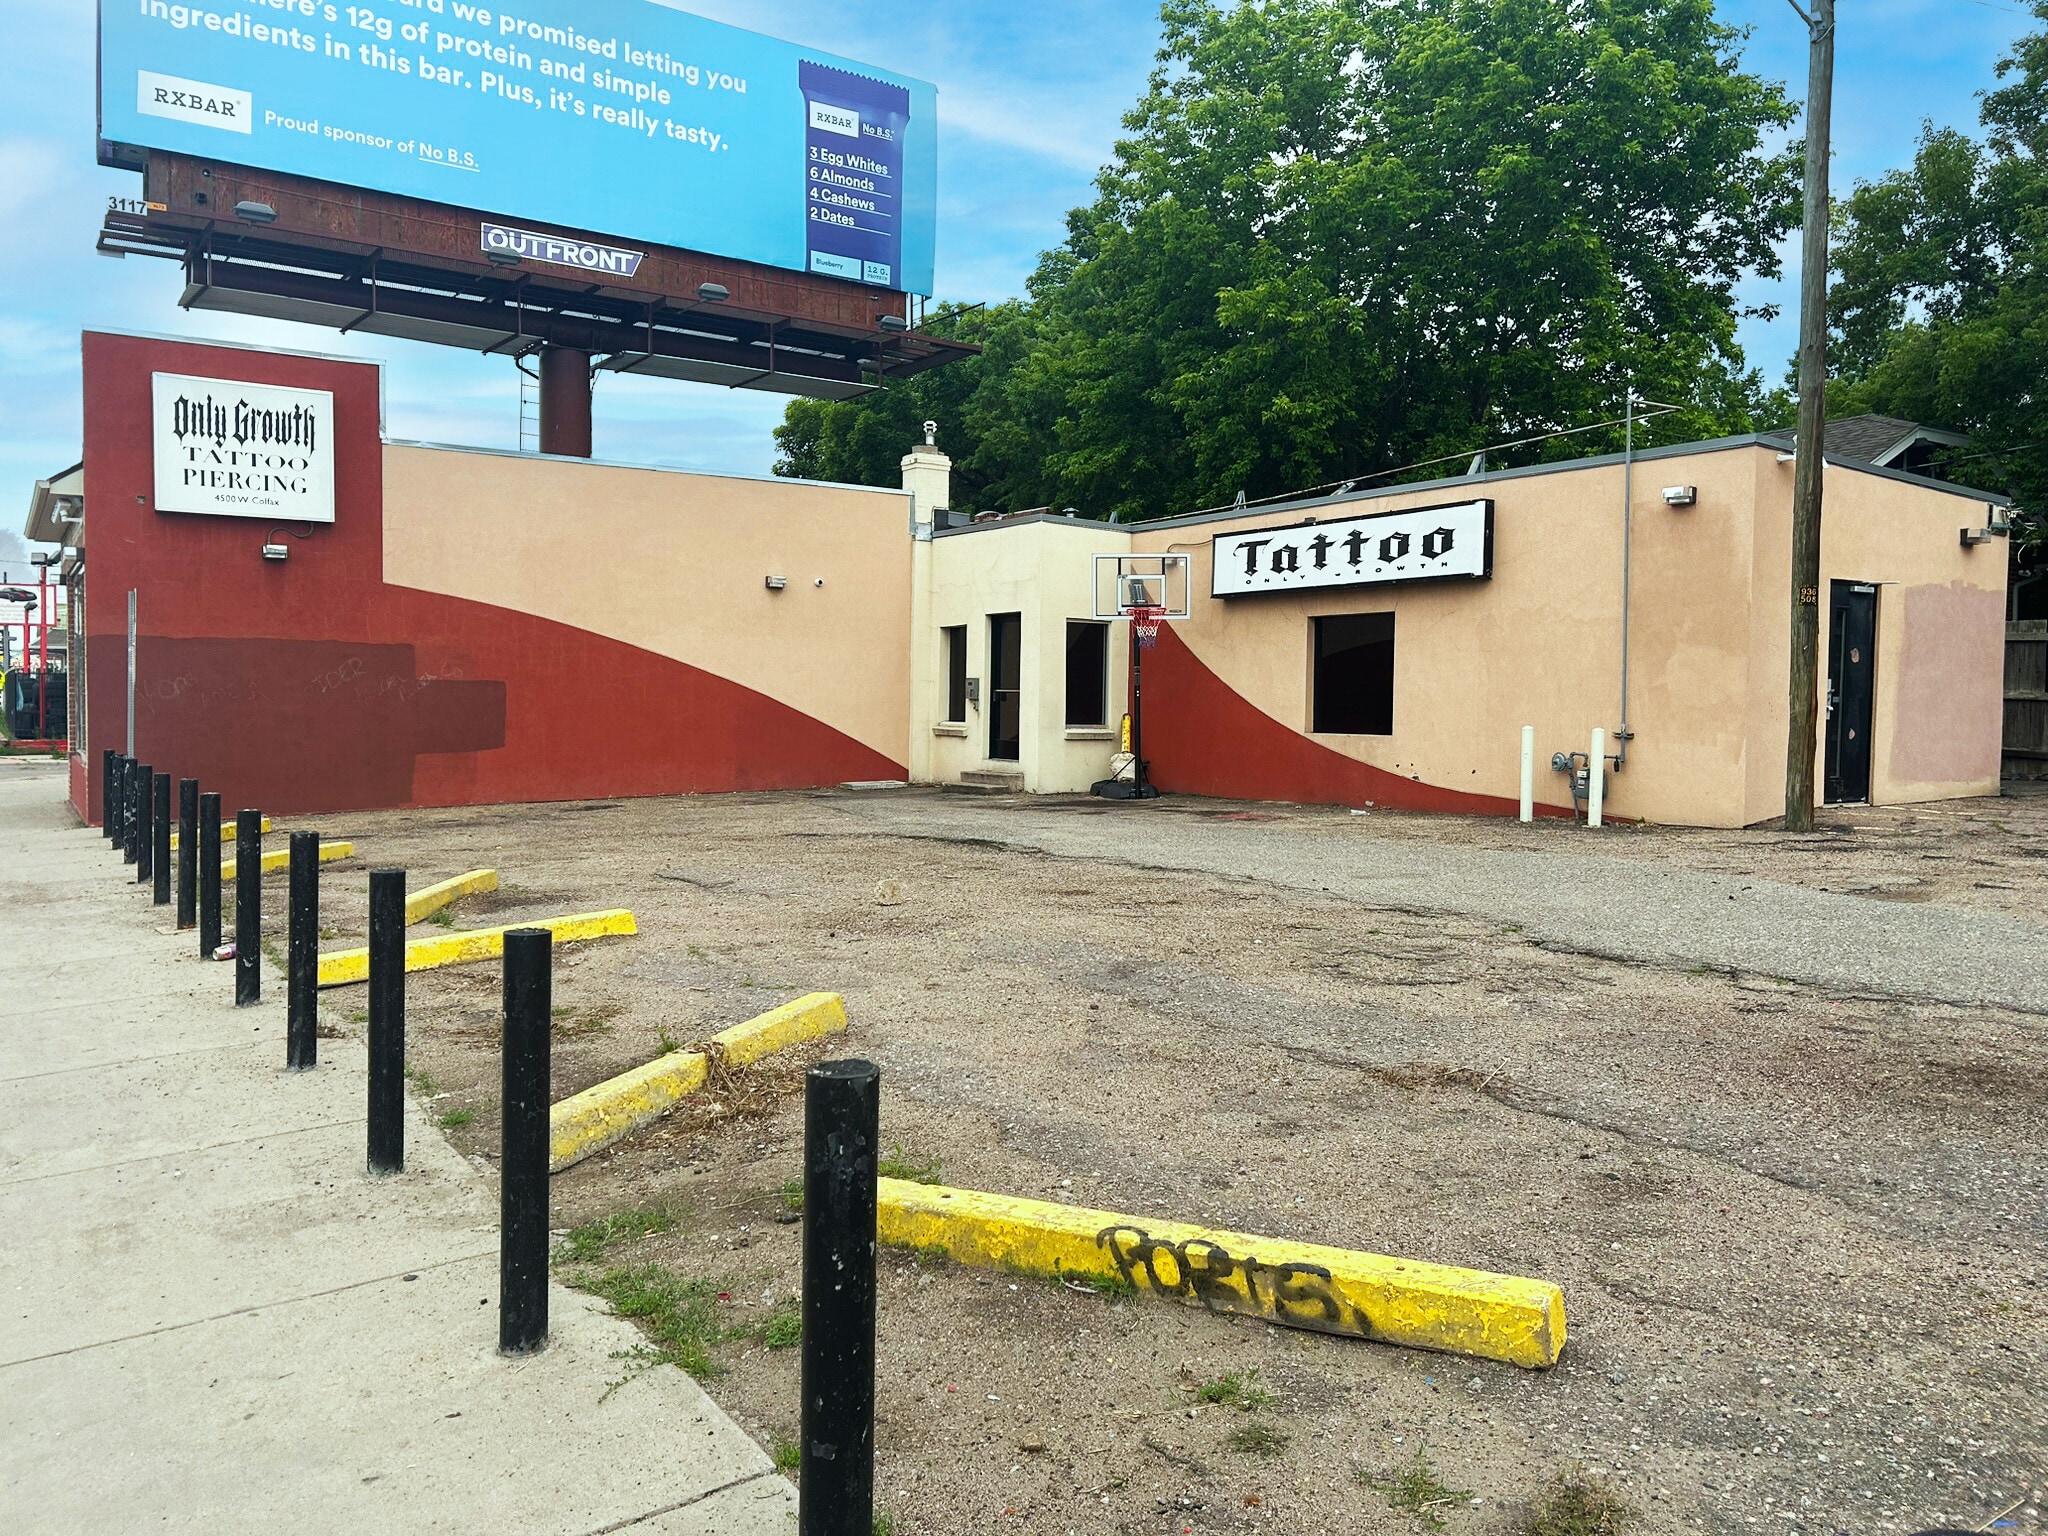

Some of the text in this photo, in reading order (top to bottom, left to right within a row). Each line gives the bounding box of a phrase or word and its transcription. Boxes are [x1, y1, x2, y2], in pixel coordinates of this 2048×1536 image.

[345, 6, 393, 41] 12g
[400, 21, 430, 44] of
[436, 31, 532, 70] protein
[539, 62, 585, 84] and
[592, 68, 671, 105] simple
[451, 2, 492, 26] we
[500, 14, 617, 60] promised
[624, 41, 700, 86] letting
[705, 69, 747, 94] you
[154, 87, 236, 118] RXBAR
[324, 32, 350, 60] in
[358, 43, 411, 74] this
[419, 55, 472, 89] bar.
[481, 70, 543, 110] Plus,
[550, 87, 586, 116] it's
[592, 103, 660, 137] really
[664, 118, 729, 152] tasty.
[816, 111, 852, 129] RXBAR
[862, 122, 875, 135] No
[264, 109, 480, 168] Proud sponsor of No B.S.
[809, 146, 888, 175] 3 Egg Whites
[809, 166, 875, 191] 6 Almonds
[108, 196, 147, 214] 3117
[809, 187, 875, 211] 4 Cashews
[810, 206, 855, 226] 2 Dates
[487, 228, 634, 273] OUTFRONT
[815, 257, 844, 270] Blueberry
[867, 265, 878, 274] 12
[173, 393, 316, 458] Only Growth
[182, 446, 309, 471] TATTOO
[183, 468, 307, 494] PIERCING
[214, 494, 236, 503] 4500
[252, 496, 280, 506] Colfax
[1232, 526, 1457, 577] Tattoo
[1245, 574, 1306, 584] ONLY
